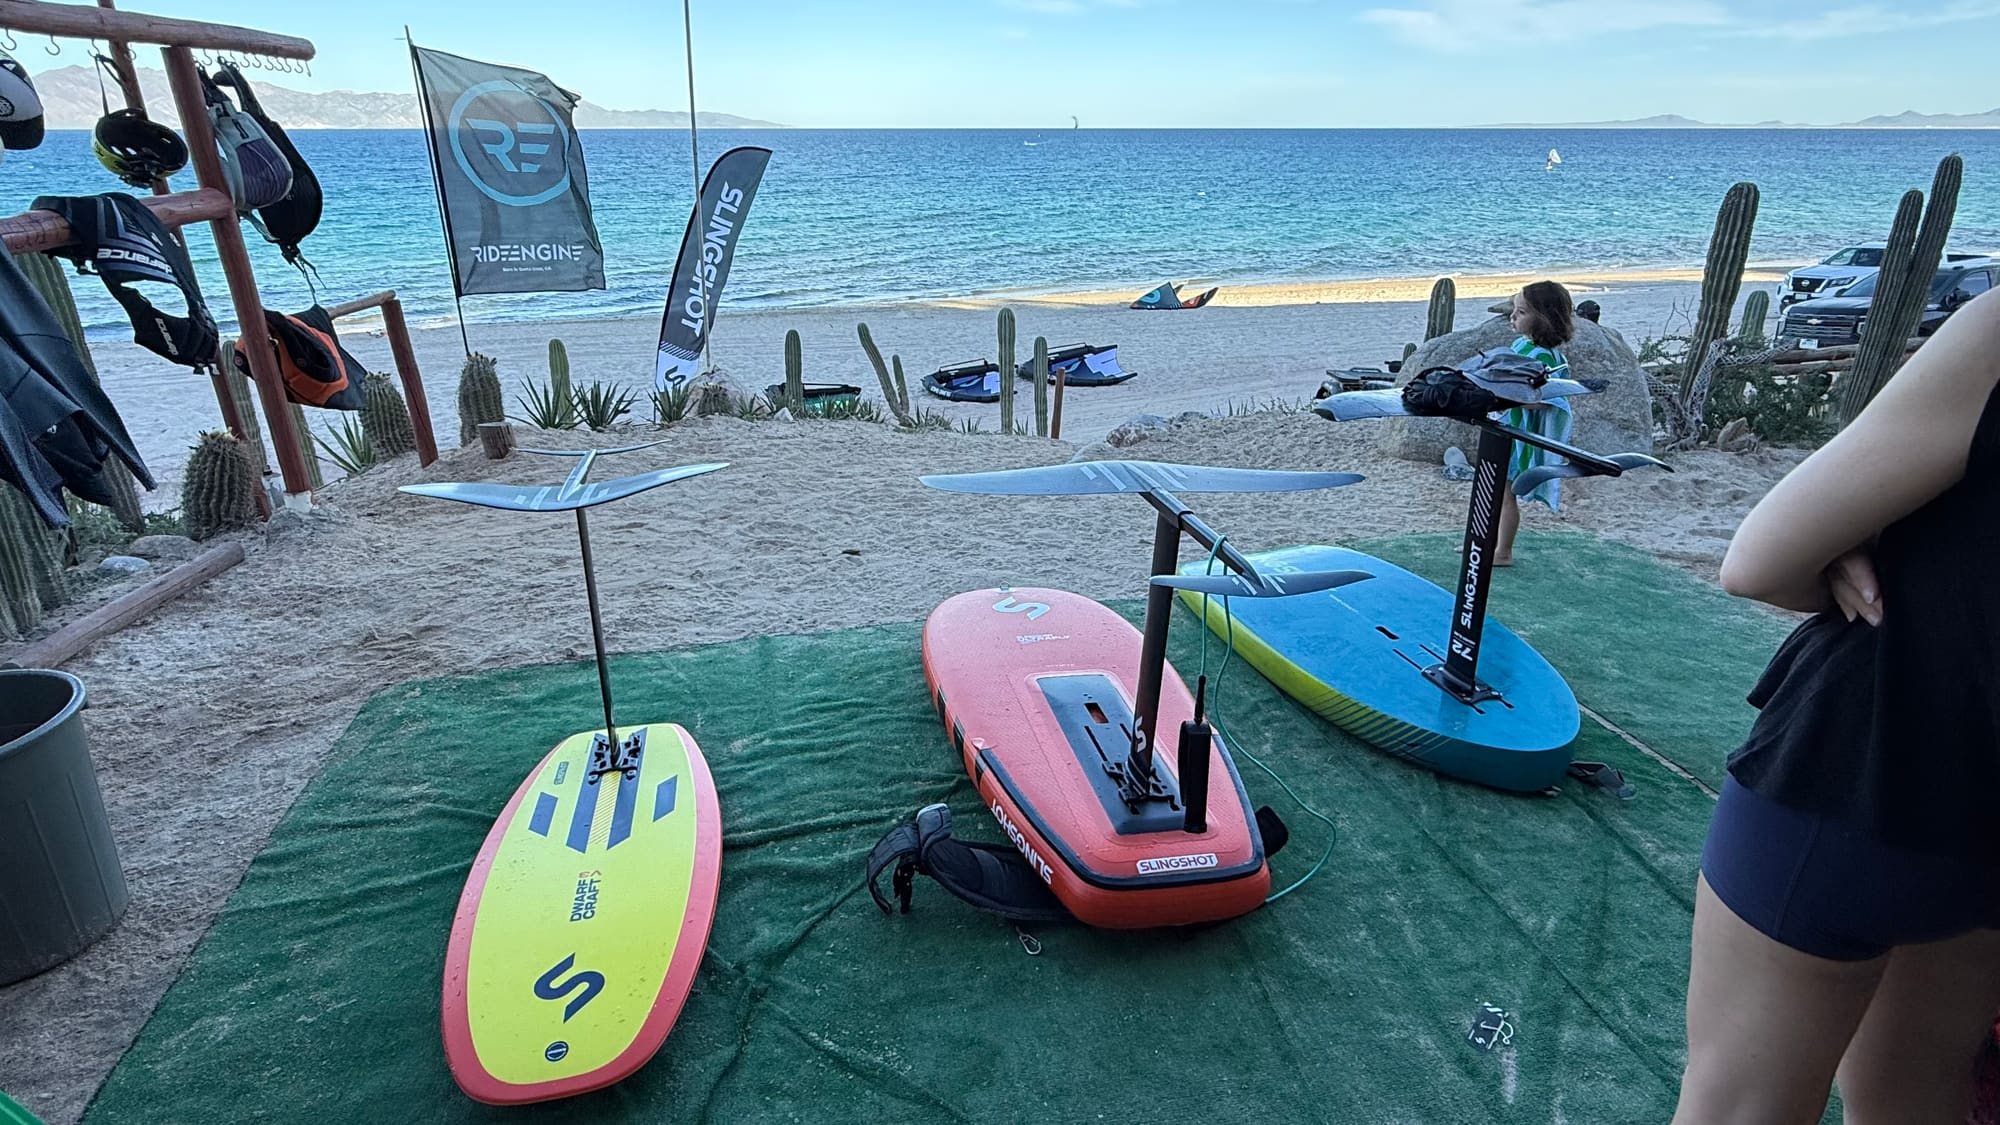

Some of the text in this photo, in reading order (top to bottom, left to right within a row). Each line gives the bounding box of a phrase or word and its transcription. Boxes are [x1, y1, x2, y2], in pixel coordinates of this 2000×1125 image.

[465, 118, 556, 173] RE
[681, 181, 744, 337] SLINGSHOT
[991, 799, 1054, 885] SLINGSHOT
[1140, 855, 1214, 871] SLINGSHOT
[570, 879, 589, 922] DWARF
[582, 878, 602, 920] CRAFT
